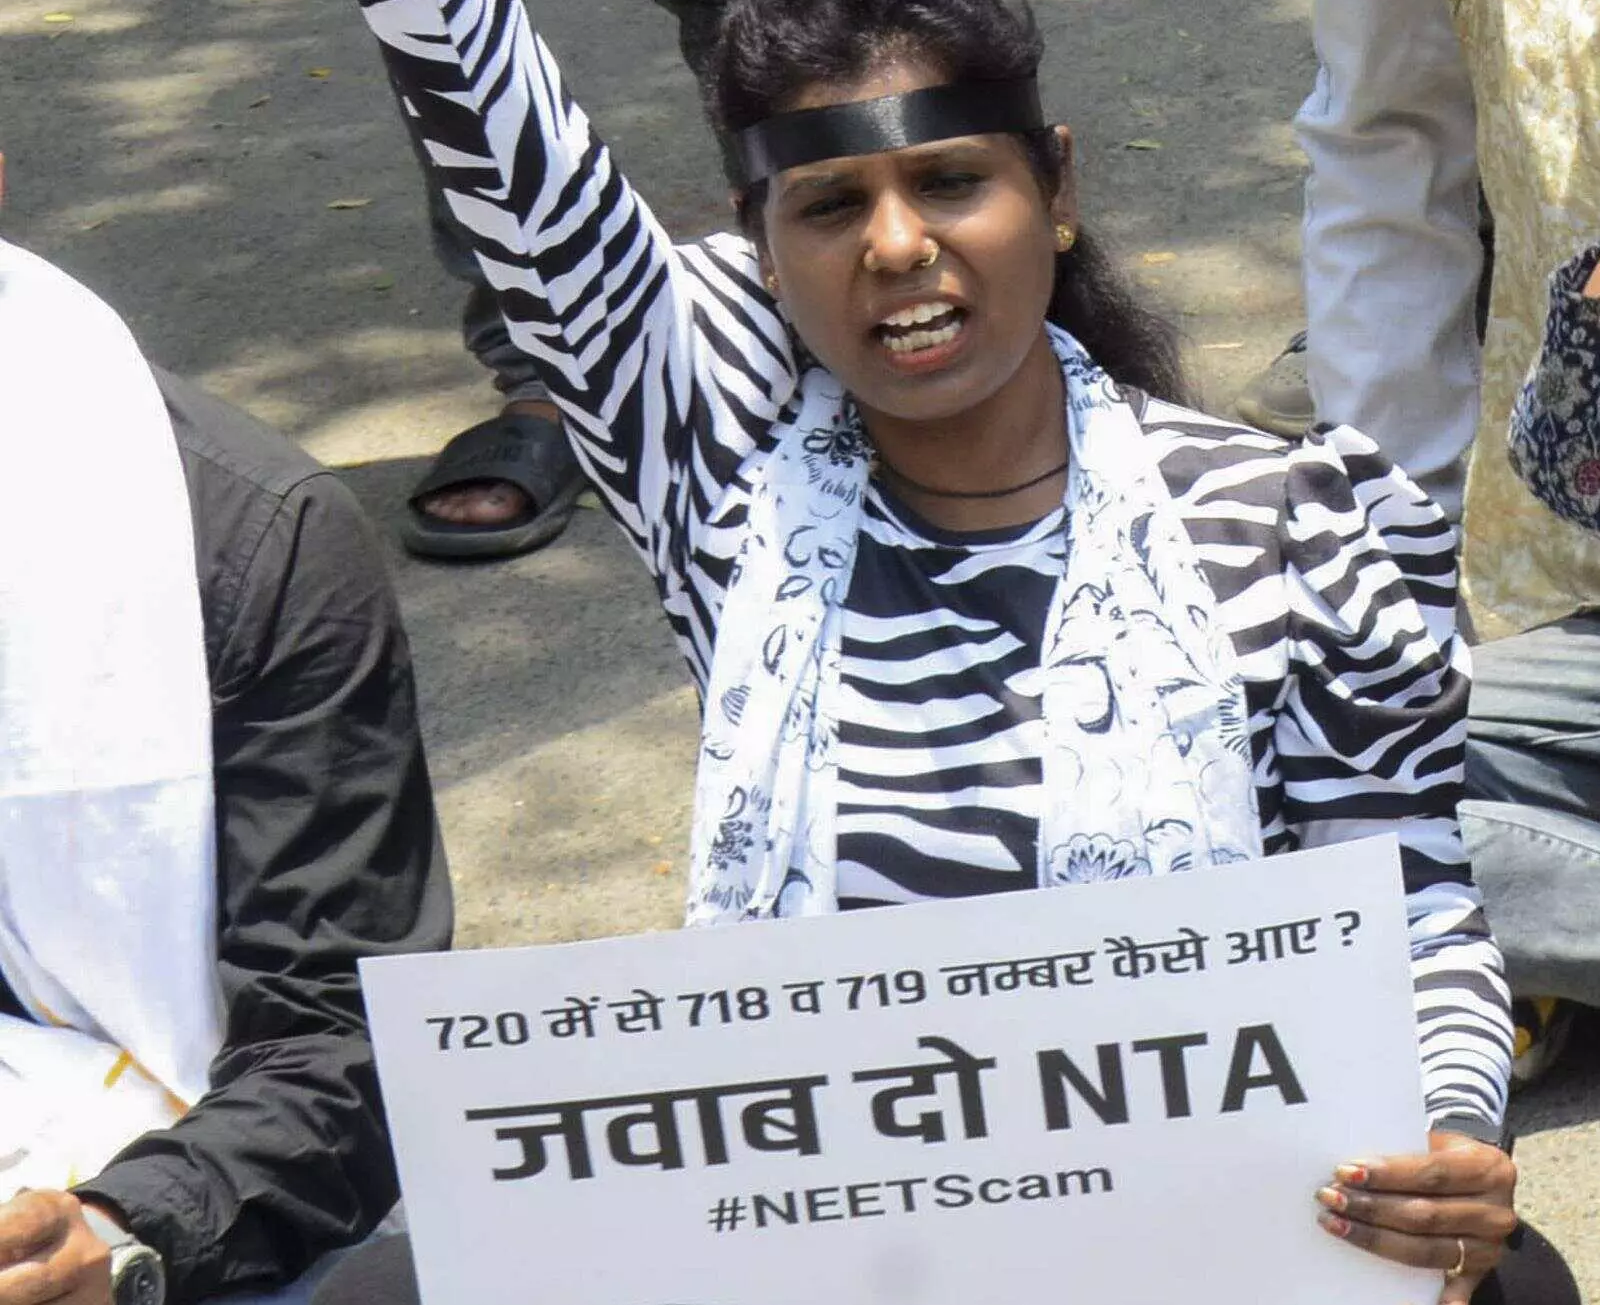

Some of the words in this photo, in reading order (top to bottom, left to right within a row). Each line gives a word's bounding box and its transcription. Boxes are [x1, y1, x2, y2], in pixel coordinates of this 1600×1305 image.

[426, 1012, 529, 1050] 720
[541, 996, 600, 1038] में
[607, 989, 665, 1033] से
[677, 987, 769, 1027] 718
[782, 981, 825, 1014] व
[836, 970, 926, 1010] 719
[939, 951, 1096, 996] नम्बर
[1103, 928, 1209, 979] कैसे
[1226, 918, 1321, 964] आए
[465, 1075, 829, 1181] जवाब
[852, 1036, 996, 1144] दो
[1036, 1024, 1308, 1131] NTA
[708, 1168, 1113, 1232] #NEETScam
